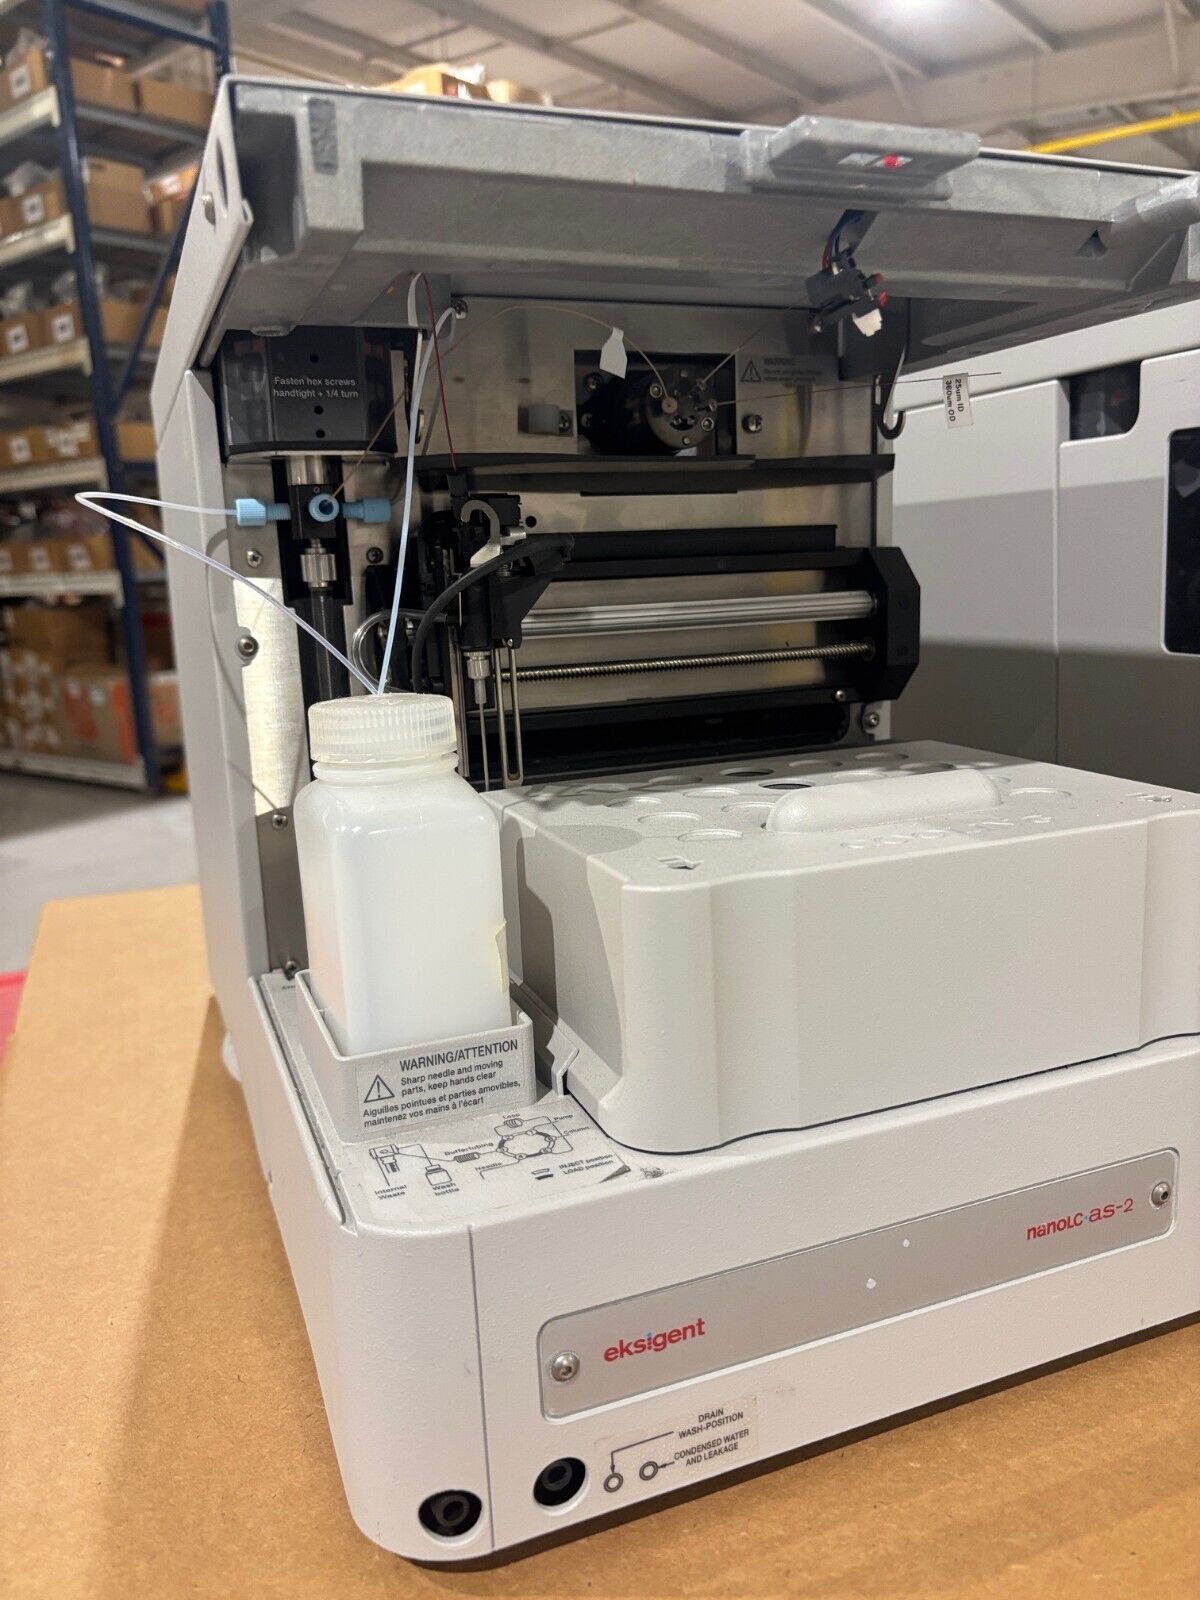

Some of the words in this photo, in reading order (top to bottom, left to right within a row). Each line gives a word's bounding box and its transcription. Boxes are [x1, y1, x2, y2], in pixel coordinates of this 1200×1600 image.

[273, 388, 316, 400] handtight
[326, 389, 339, 398] 1/4
[341, 390, 359, 398] turn
[948, 409, 956, 422] OD
[957, 403, 965, 412] ID
[399, 1038, 518, 1073] WARNING/ATTENTION
[401, 1075, 426, 1086] Sharp
[428, 1068, 455, 1081] needle
[457, 1064, 472, 1075] and
[474, 1060, 503, 1072] moving
[401, 1085, 426, 1097] parts,
[428, 1081, 447, 1091] keep
[449, 1075, 474, 1086] hands
[476, 1071, 496, 1081] clear
[363, 1104, 399, 1118] Aiguilles
[401, 1097, 437, 1111] pointues
[438, 1093, 447, 1102] et
[448, 1088, 476, 1101] parties
[478, 1080, 521, 1094] amovibles,
[364, 1113, 407, 1127] maintenez
[409, 1109, 424, 1118] vos
[425, 1104, 450, 1115] mains
[451, 1101, 457, 1110] à
[563, 1166, 584, 1175] LOAD
[603, 1317, 706, 1362] eksigent
[679, 1411, 744, 1439] WASH-POSITION
[698, 1408, 724, 1423] DRAIN
[674, 1437, 722, 1460] CONDENSED
[723, 1428, 749, 1443] WATER
[686, 1455, 702, 1467] AND
[704, 1442, 739, 1460] LEAKAGE
